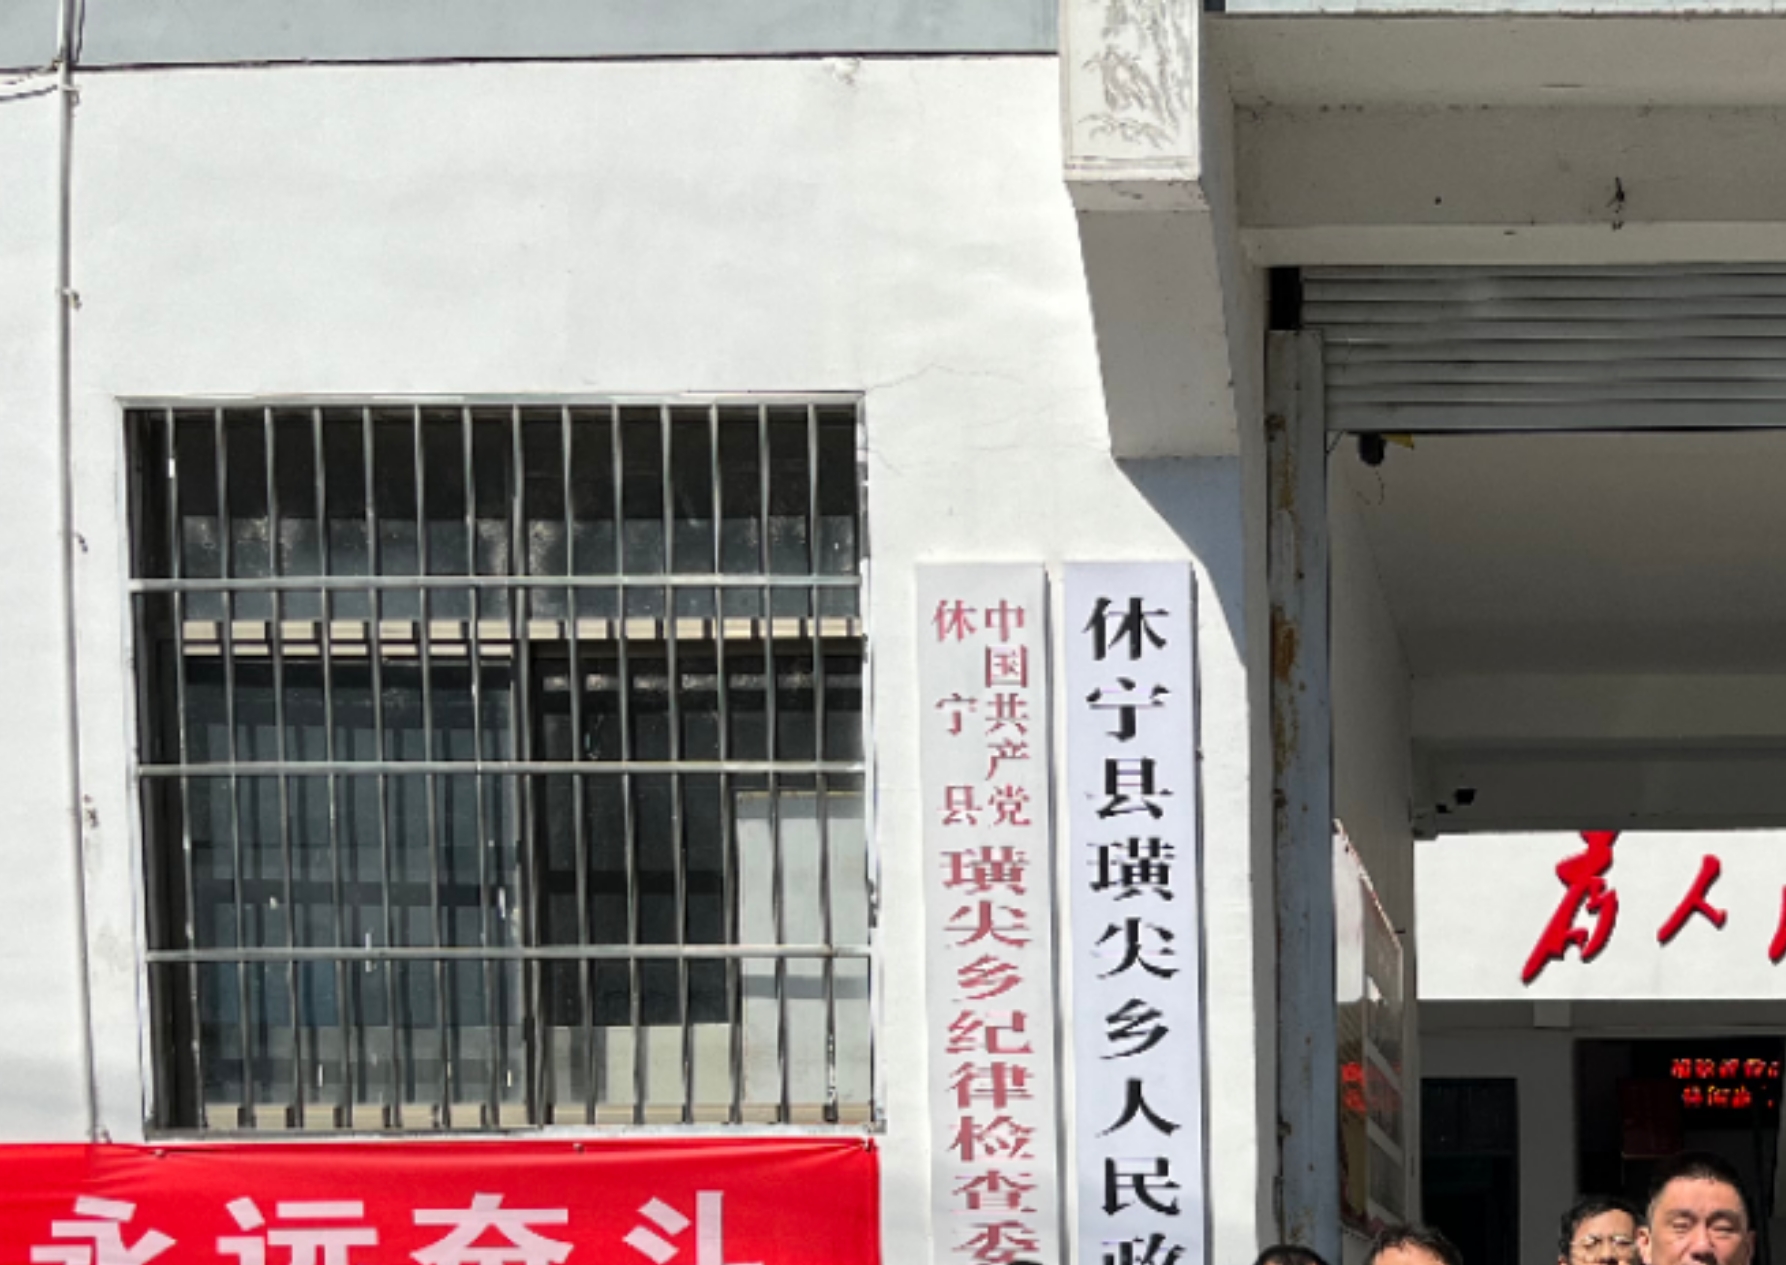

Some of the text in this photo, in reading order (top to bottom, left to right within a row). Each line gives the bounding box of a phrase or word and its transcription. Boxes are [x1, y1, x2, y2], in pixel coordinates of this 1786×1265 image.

[985, 599, 1031, 827] 中国共产党
